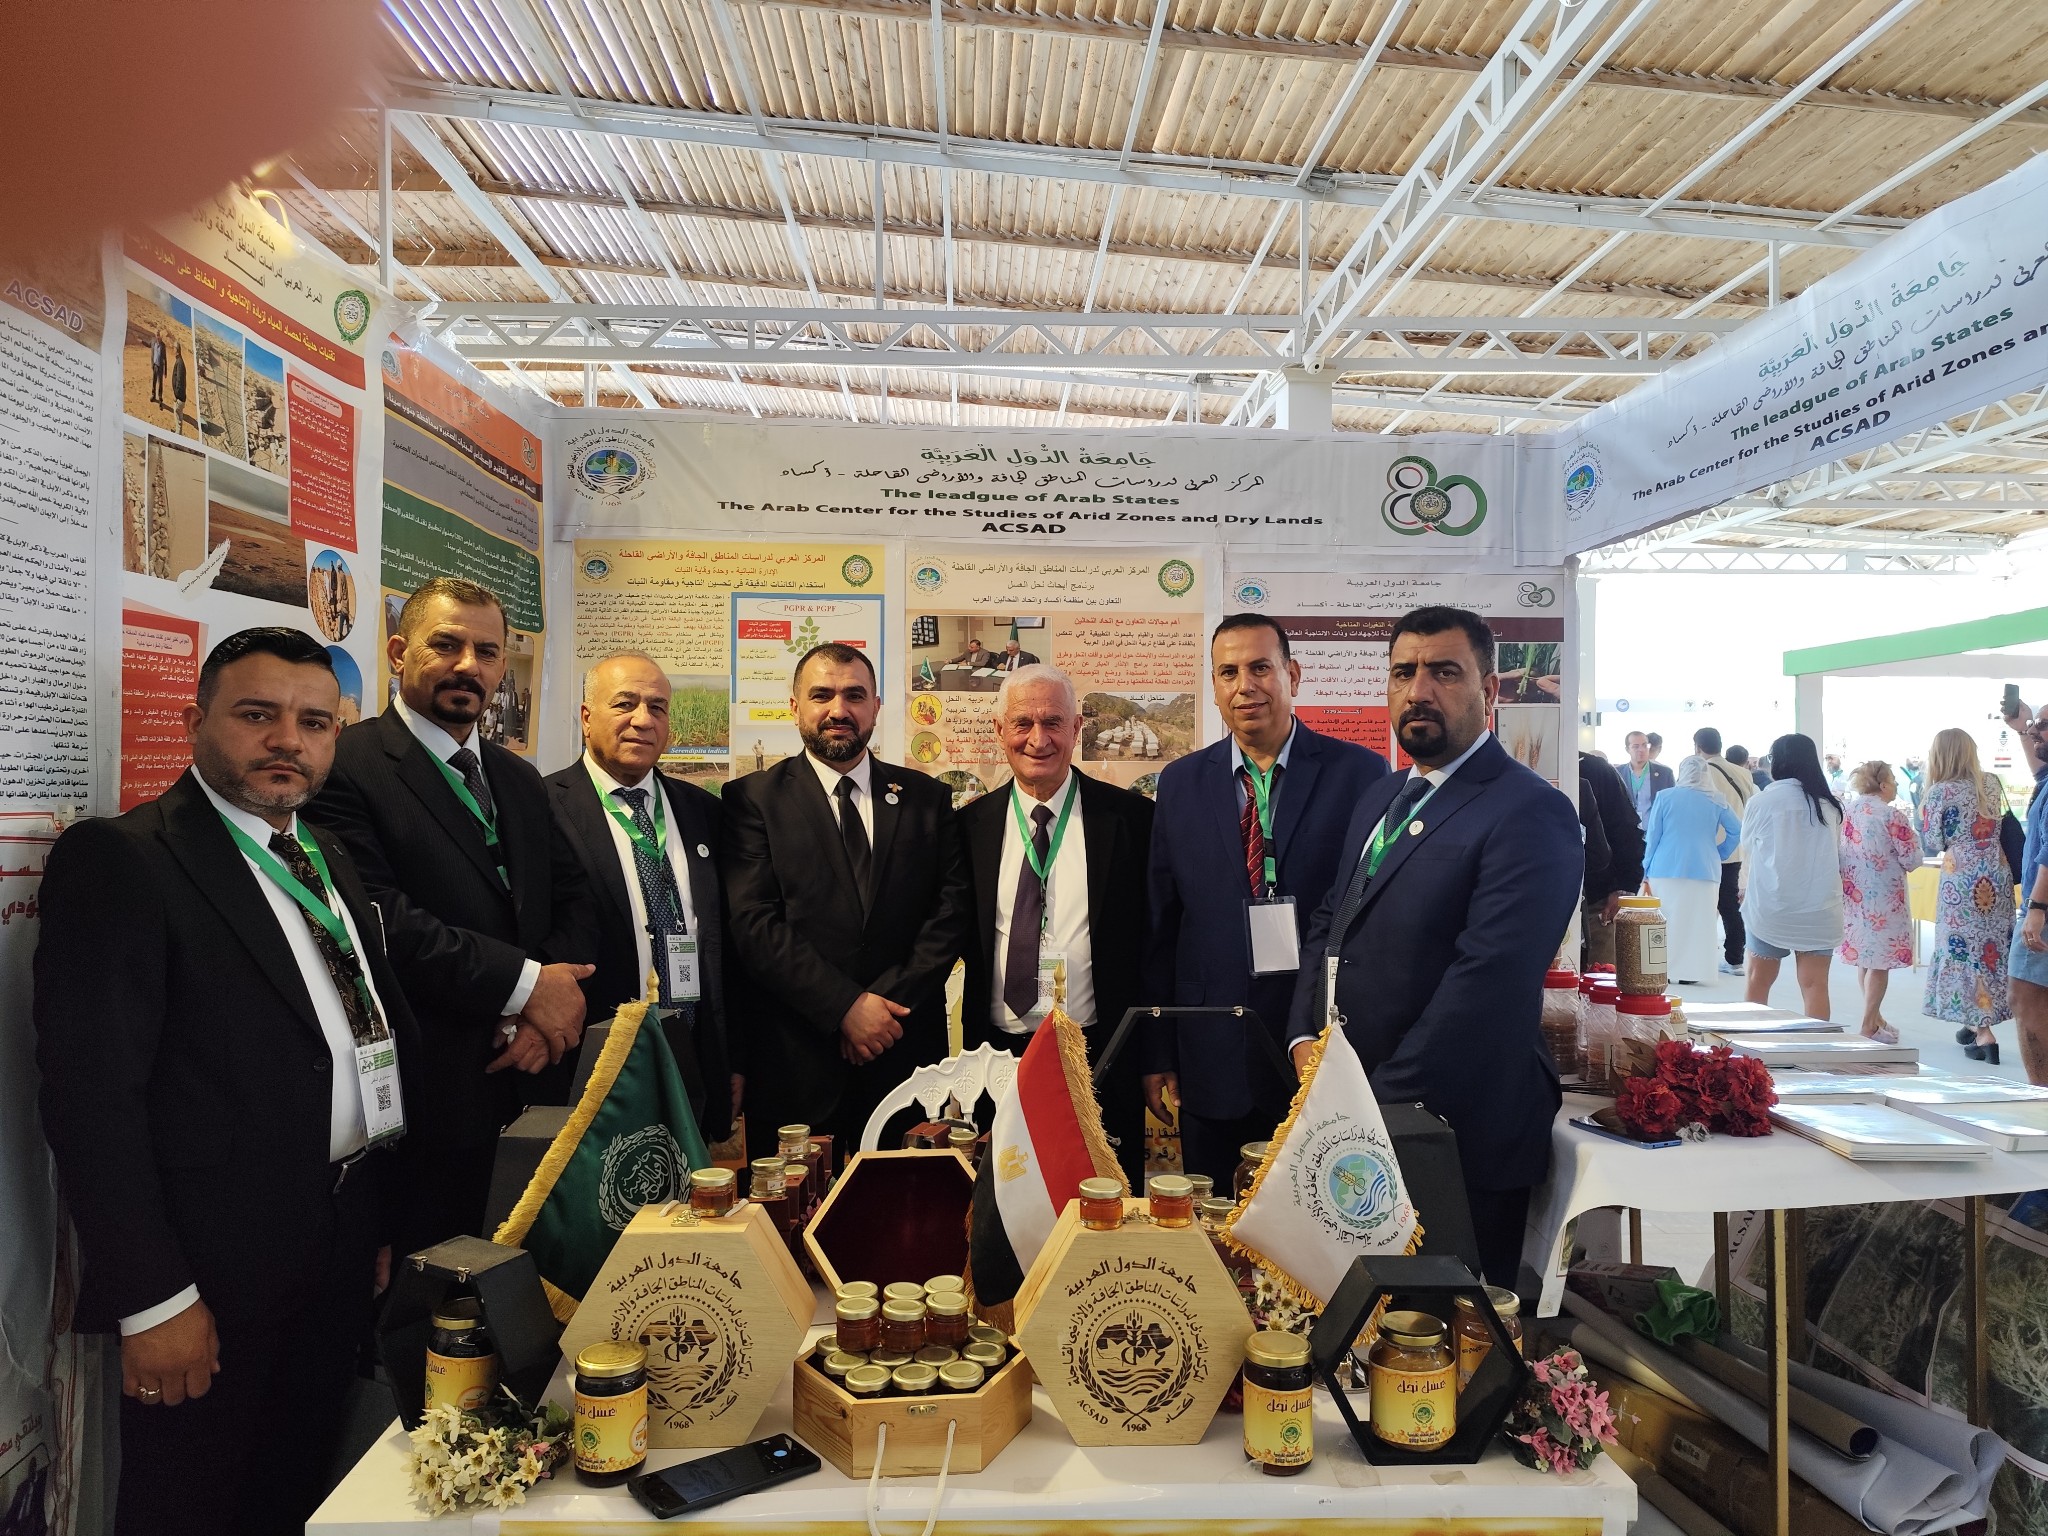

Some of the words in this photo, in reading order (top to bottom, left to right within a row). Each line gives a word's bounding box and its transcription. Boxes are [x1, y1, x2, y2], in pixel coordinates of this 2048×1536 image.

[4, 279, 83, 333] ACSAD
[1730, 422, 1760, 441] The
[1763, 387, 1840, 427] leadgue
[1845, 370, 1868, 391] of
[1873, 348, 1926, 379] Arab
[1931, 307, 2014, 352] States
[1632, 489, 1652, 501] The
[1655, 474, 1686, 492] Arab
[1689, 455, 1735, 479] Center
[1738, 444, 1759, 461] for
[1763, 432, 1790, 450] the
[1793, 403, 1861, 438] Studies
[1865, 389, 1887, 408] of
[1891, 368, 1936, 398] Arid
[1941, 338, 2016, 377] Zones
[1810, 410, 1891, 451] ACSAD
[880, 488, 922, 499] The
[928, 489, 1018, 503] leadgue
[1024, 492, 1048, 502] of
[1053, 493, 1106, 503] Arab
[1112, 495, 1180, 505] States
[717, 501, 755, 511] The
[761, 503, 809, 512] Arab
[815, 504, 883, 515] Center
[888, 506, 918, 516] for
[924, 507, 957, 517] the
[962, 509, 1037, 519] Studies
[1042, 510, 1064, 520] of
[1069, 511, 1110, 521] Arid
[1116, 512, 1176, 522] Zones
[1181, 514, 1218, 523] and
[1224, 515, 1259, 526] Dry
[1265, 515, 1323, 525] Lands
[982, 522, 1066, 534] ACSAD
[619, 549, 644, 558] القاحلة
[646, 550, 683, 561] والأراضي
[685, 550, 707, 561] الجافة
[711, 552, 739, 563] المناطق
[742, 553, 773, 563] لدراسات
[775, 554, 799, 564] العربي
[803, 554, 826, 564] المركز
[951, 562, 976, 571] القاحلة
[978, 563, 1013, 575] والأراضي
[1015, 564, 1036, 574] الجافة
[1039, 564, 1067, 575] المناطق
[1069, 565, 1099, 575] لدراسات
[1101, 565, 1125, 577] العربي
[1127, 565, 1150, 575] المركز
[1346, 578, 1381, 588] العربية
[1383, 579, 1409, 588] الدول
[1412, 579, 1442, 588] جامعة
[1369, 591, 1395, 599] العربي
[1397, 591, 1418, 599] المركز
[1314, 1111, 1350, 1132] جامعة
[1298, 1129, 1315, 1162] الدول
[1289, 1164, 1301, 1207] العربية
[1398, 1204, 1411, 1229] 1968
[1377, 1230, 1400, 1247] ACSAD
[657, 1252, 701, 1270] الدول
[1113, 1256, 1156, 1273] الدول
[606, 1255, 654, 1294] العربية
[702, 1256, 742, 1290] جامعة
[1064, 1260, 1111, 1298] العربية
[1158, 1260, 1197, 1295] جامعة
[1396, 1379, 1419, 1394] نحل
[1421, 1380, 1446, 1394] عسل
[1077, 1399, 1109, 1425] ACSAD
[1266, 1397, 1288, 1413] نحل
[1291, 1398, 1312, 1413] عسل
[588, 1405, 616, 1420] عسل
[669, 1421, 690, 1429] 1968
[1126, 1423, 1147, 1432] 1968
